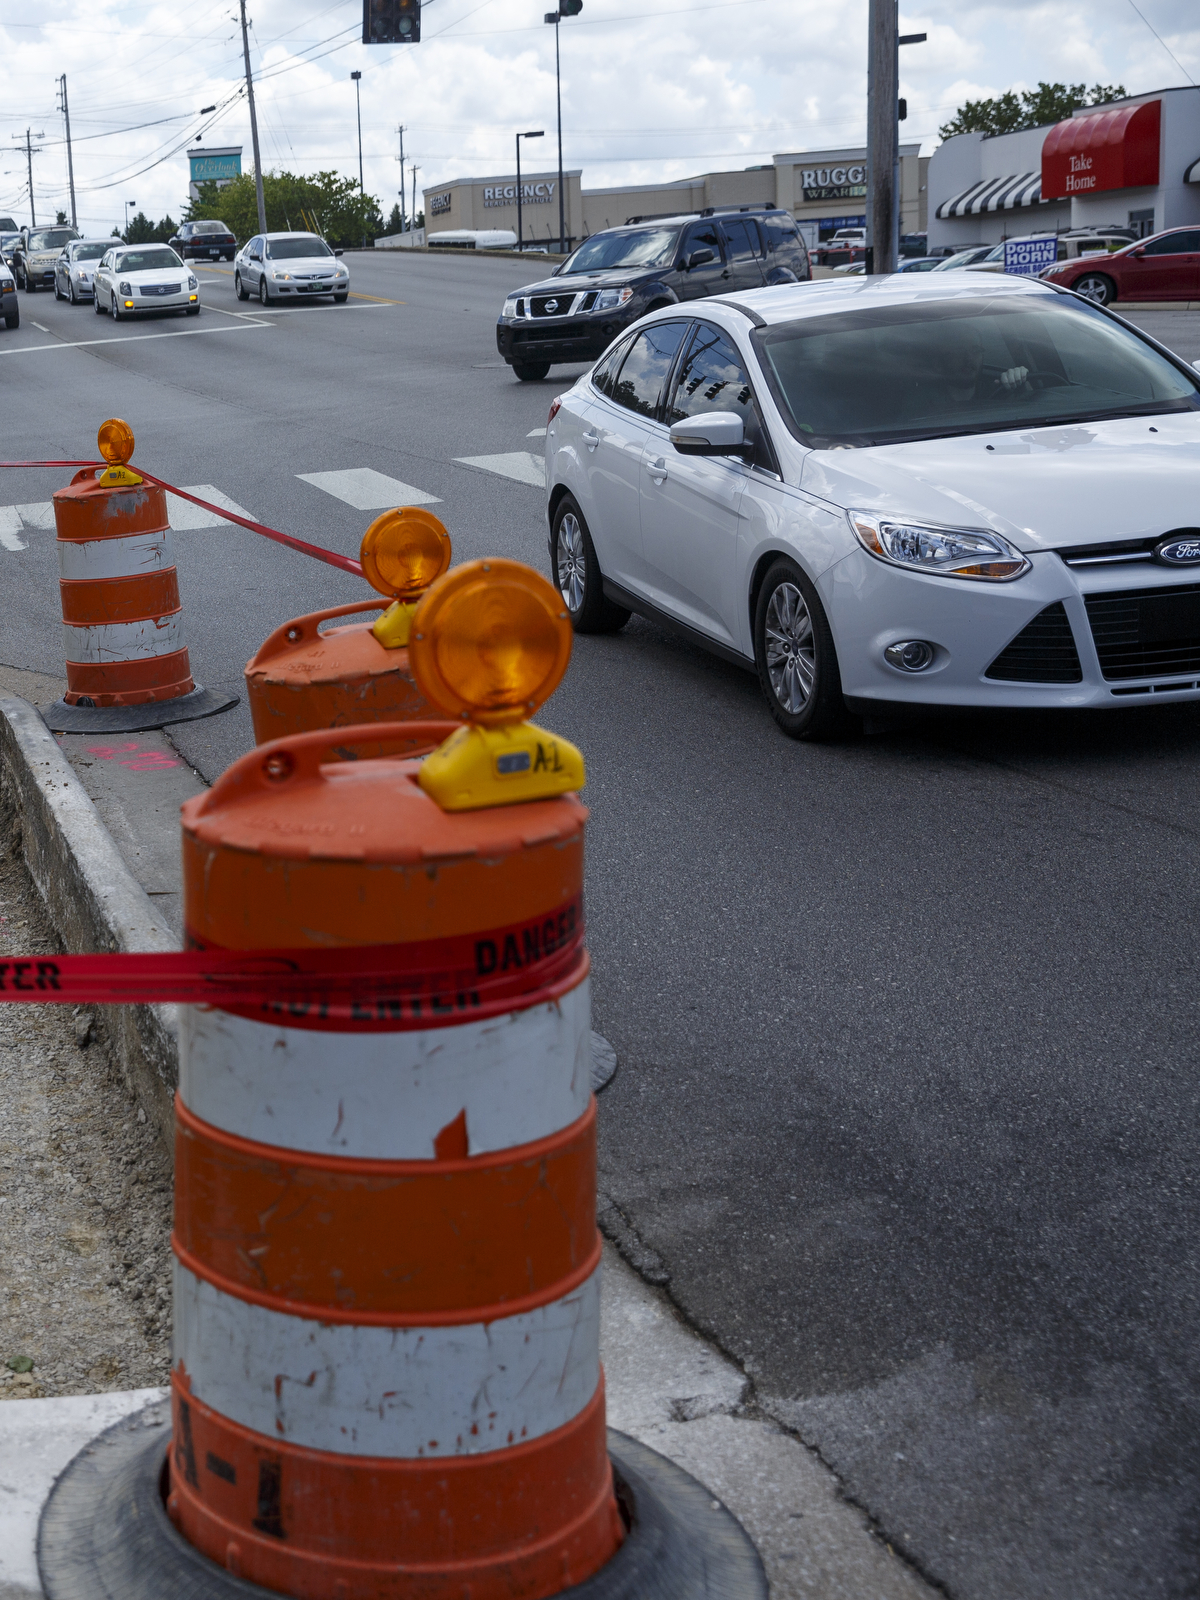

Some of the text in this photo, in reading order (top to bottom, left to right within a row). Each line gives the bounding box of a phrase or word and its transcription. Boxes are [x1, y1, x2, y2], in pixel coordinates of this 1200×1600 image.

[1069, 154, 1093, 172] Take
[484, 182, 556, 200] REGENCY
[1066, 175, 1096, 191] Home
[1006, 242, 1055, 254] Donna
[1006, 250, 1055, 264] HORN
[1005, 265, 1031, 274] SCHOOL
[1176, 542, 1200, 558] For
[474, 904, 579, 976] DANGER
